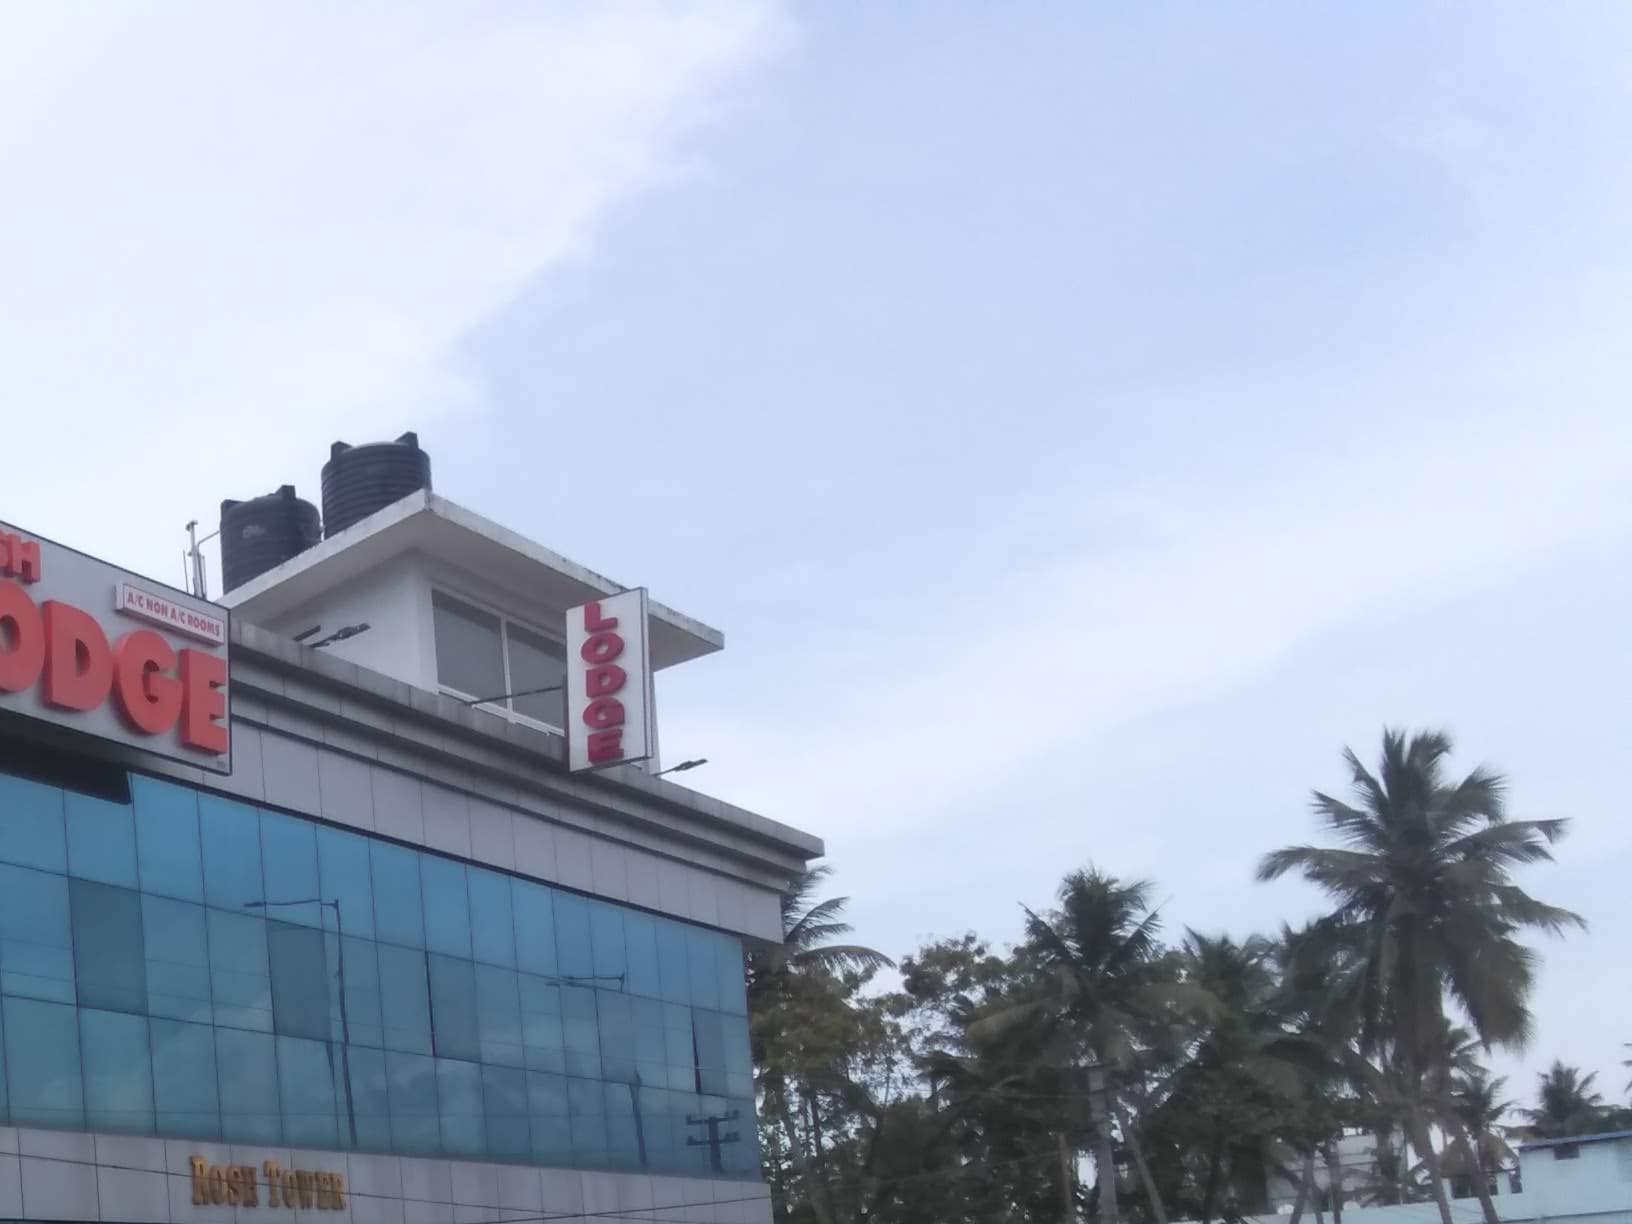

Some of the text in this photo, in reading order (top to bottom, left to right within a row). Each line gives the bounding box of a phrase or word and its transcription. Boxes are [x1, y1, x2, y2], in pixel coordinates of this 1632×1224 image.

[127, 592, 220, 637] A/C NON A/C ROOMS
[580, 601, 627, 764] LODGE
[191, 1155, 259, 1208] ROSH
